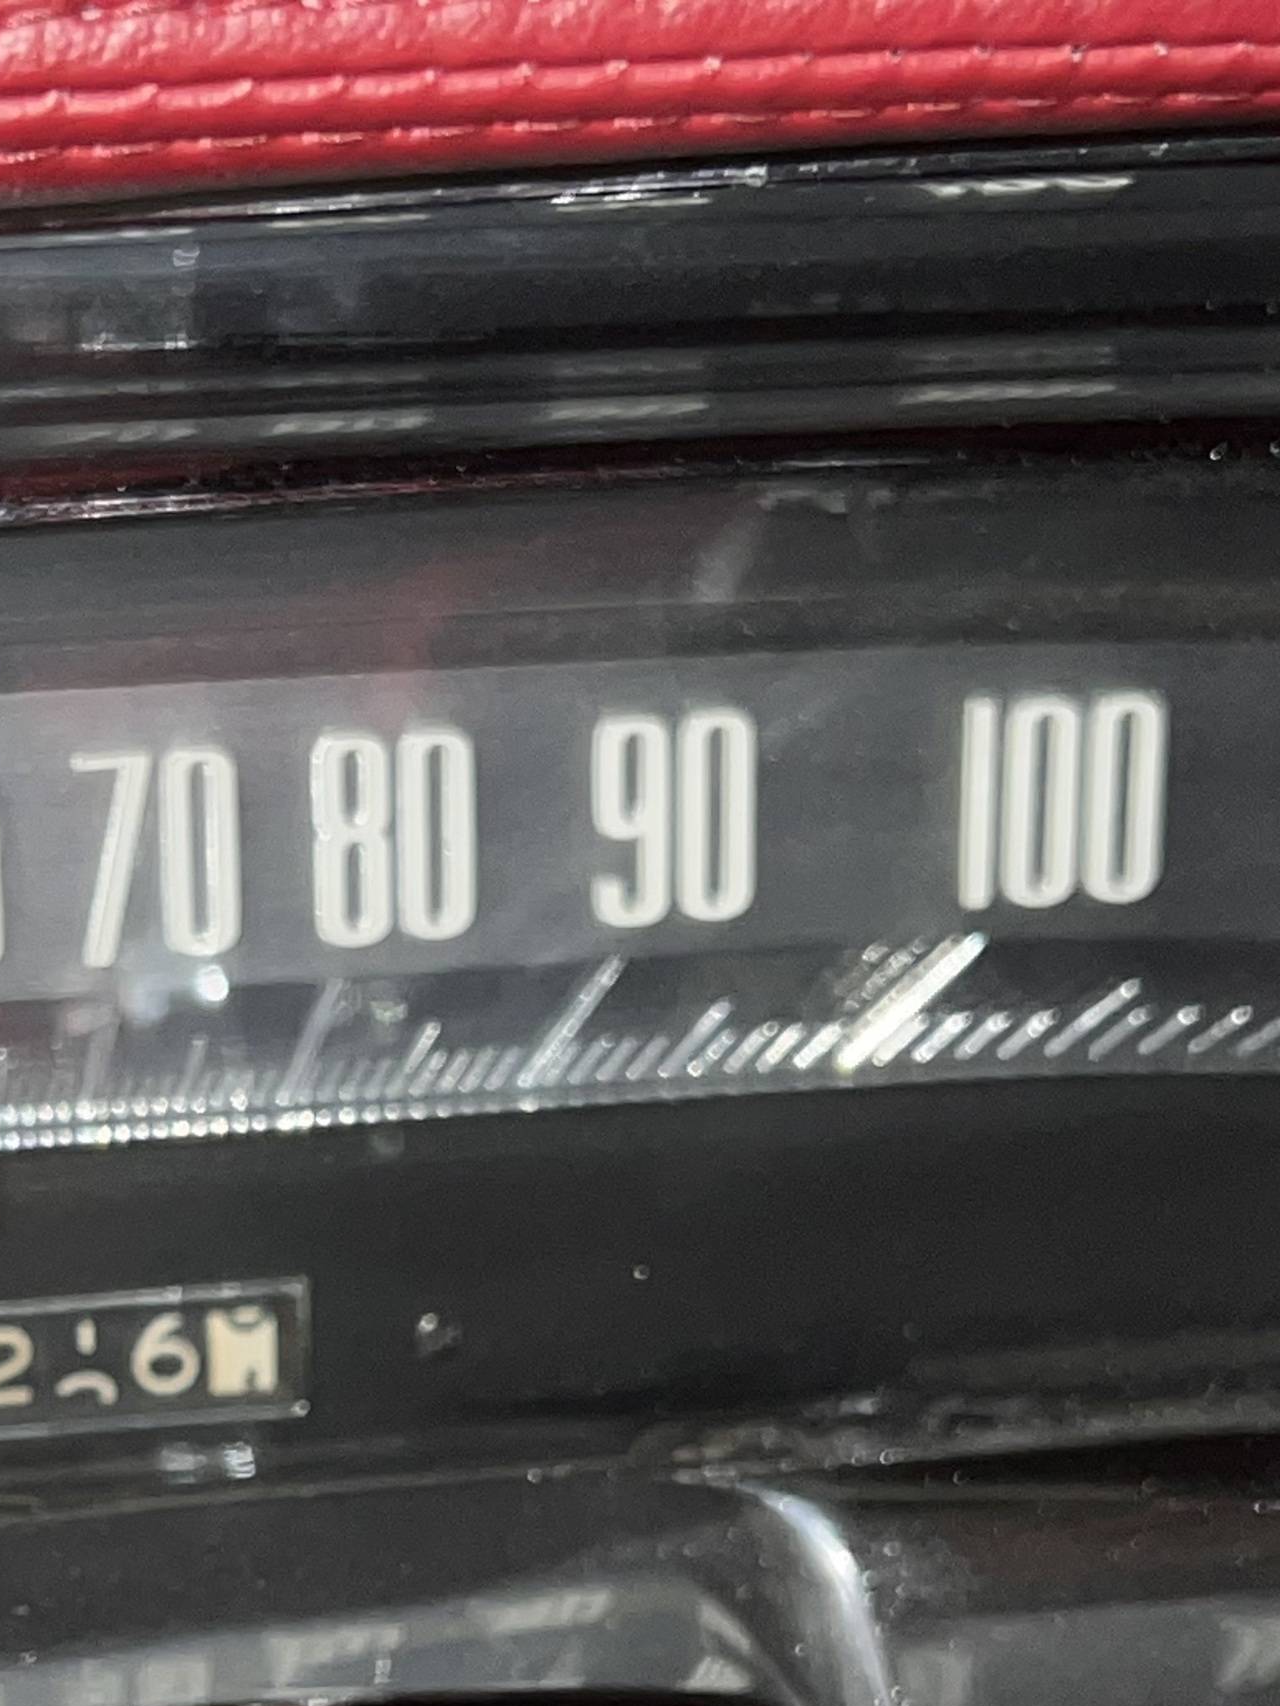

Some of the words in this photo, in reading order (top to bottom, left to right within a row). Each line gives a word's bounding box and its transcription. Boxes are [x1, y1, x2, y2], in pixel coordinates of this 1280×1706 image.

[70, 745, 244, 969] 70
[310, 725, 478, 949] 80
[590, 704, 759, 930] 90
[956, 688, 1172, 912] 100
